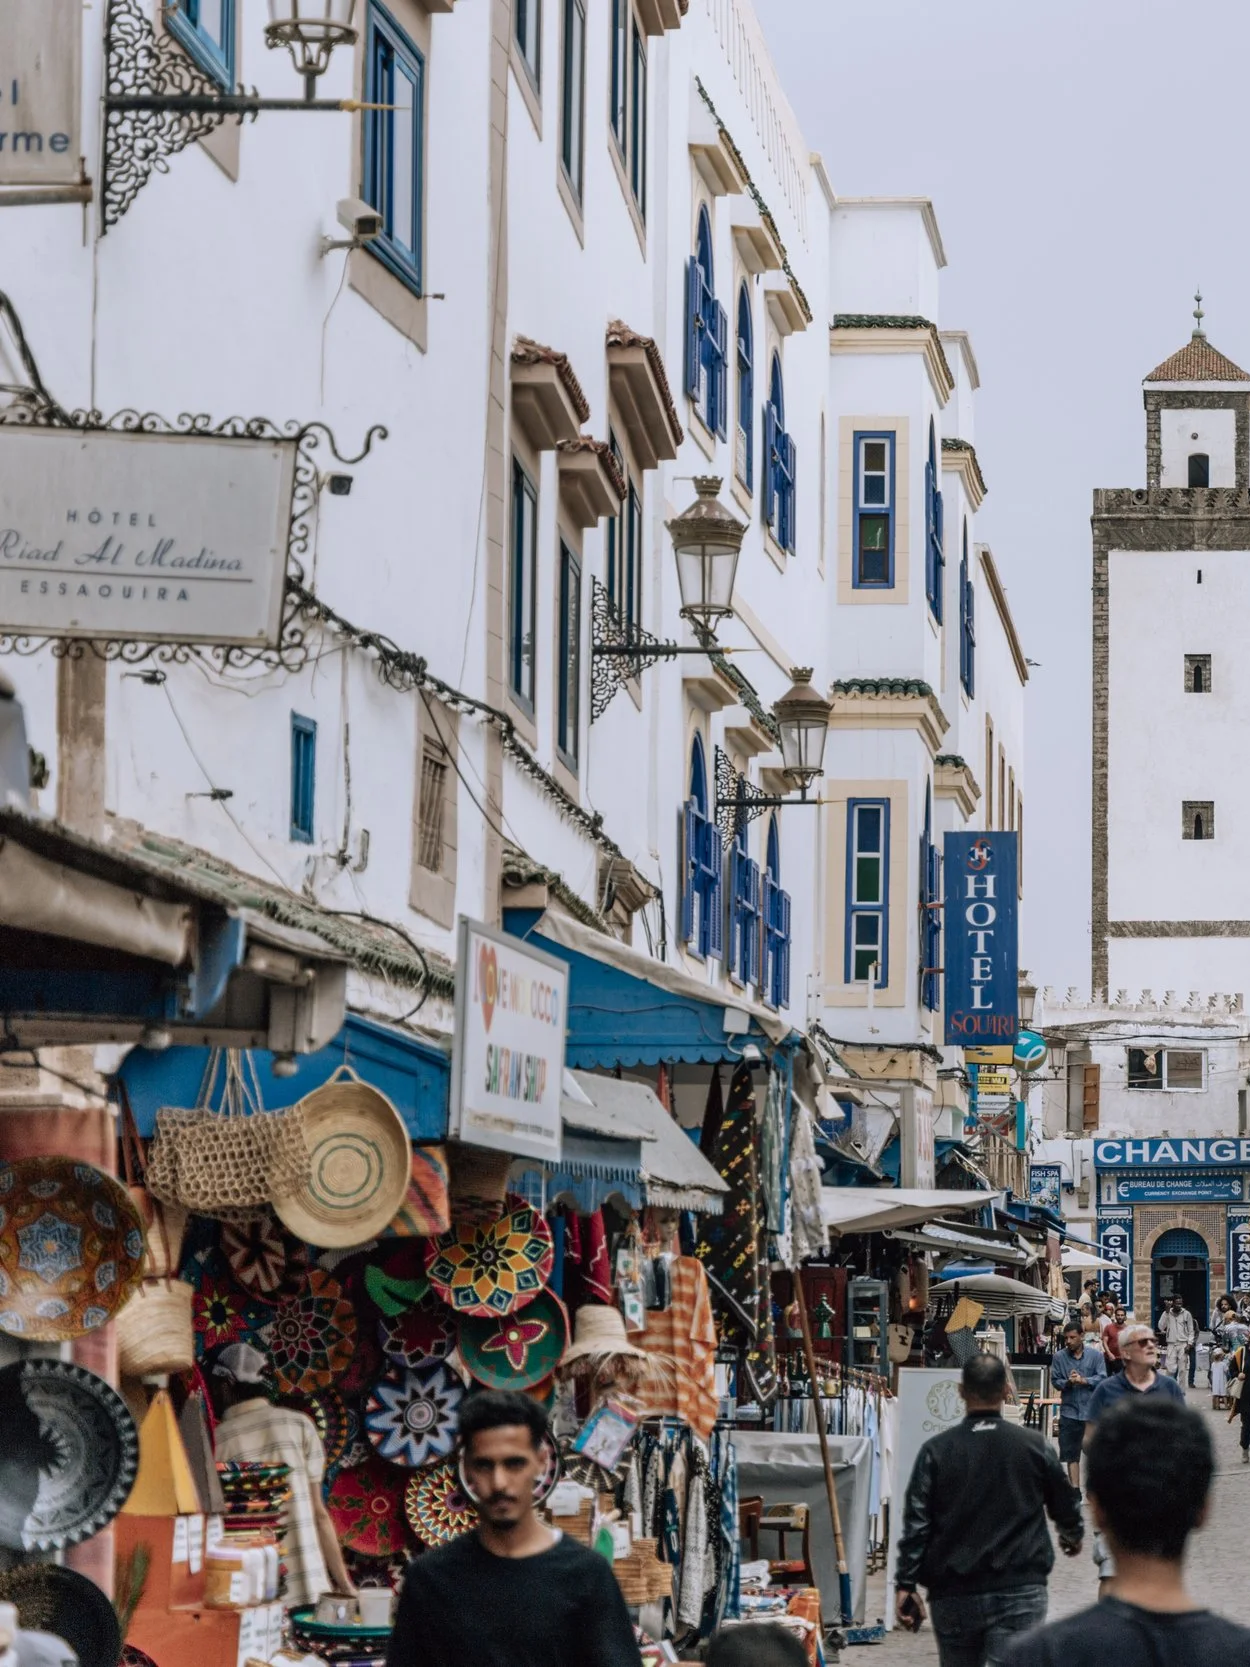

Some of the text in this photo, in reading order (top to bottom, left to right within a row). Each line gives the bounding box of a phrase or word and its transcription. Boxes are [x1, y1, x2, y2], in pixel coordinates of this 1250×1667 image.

[66, 507, 156, 528] HÔTEL
[0, 528, 243, 571] Riad Al Madina
[21, 579, 190, 601] ESSAOUIRA
[964, 875, 997, 1009] HOTEL
[951, 1010, 1014, 1037] SOUIRI
[485, 1043, 547, 1104] SAFRAN SHOP
[1238, 1234, 1250, 1289] CHANGE
